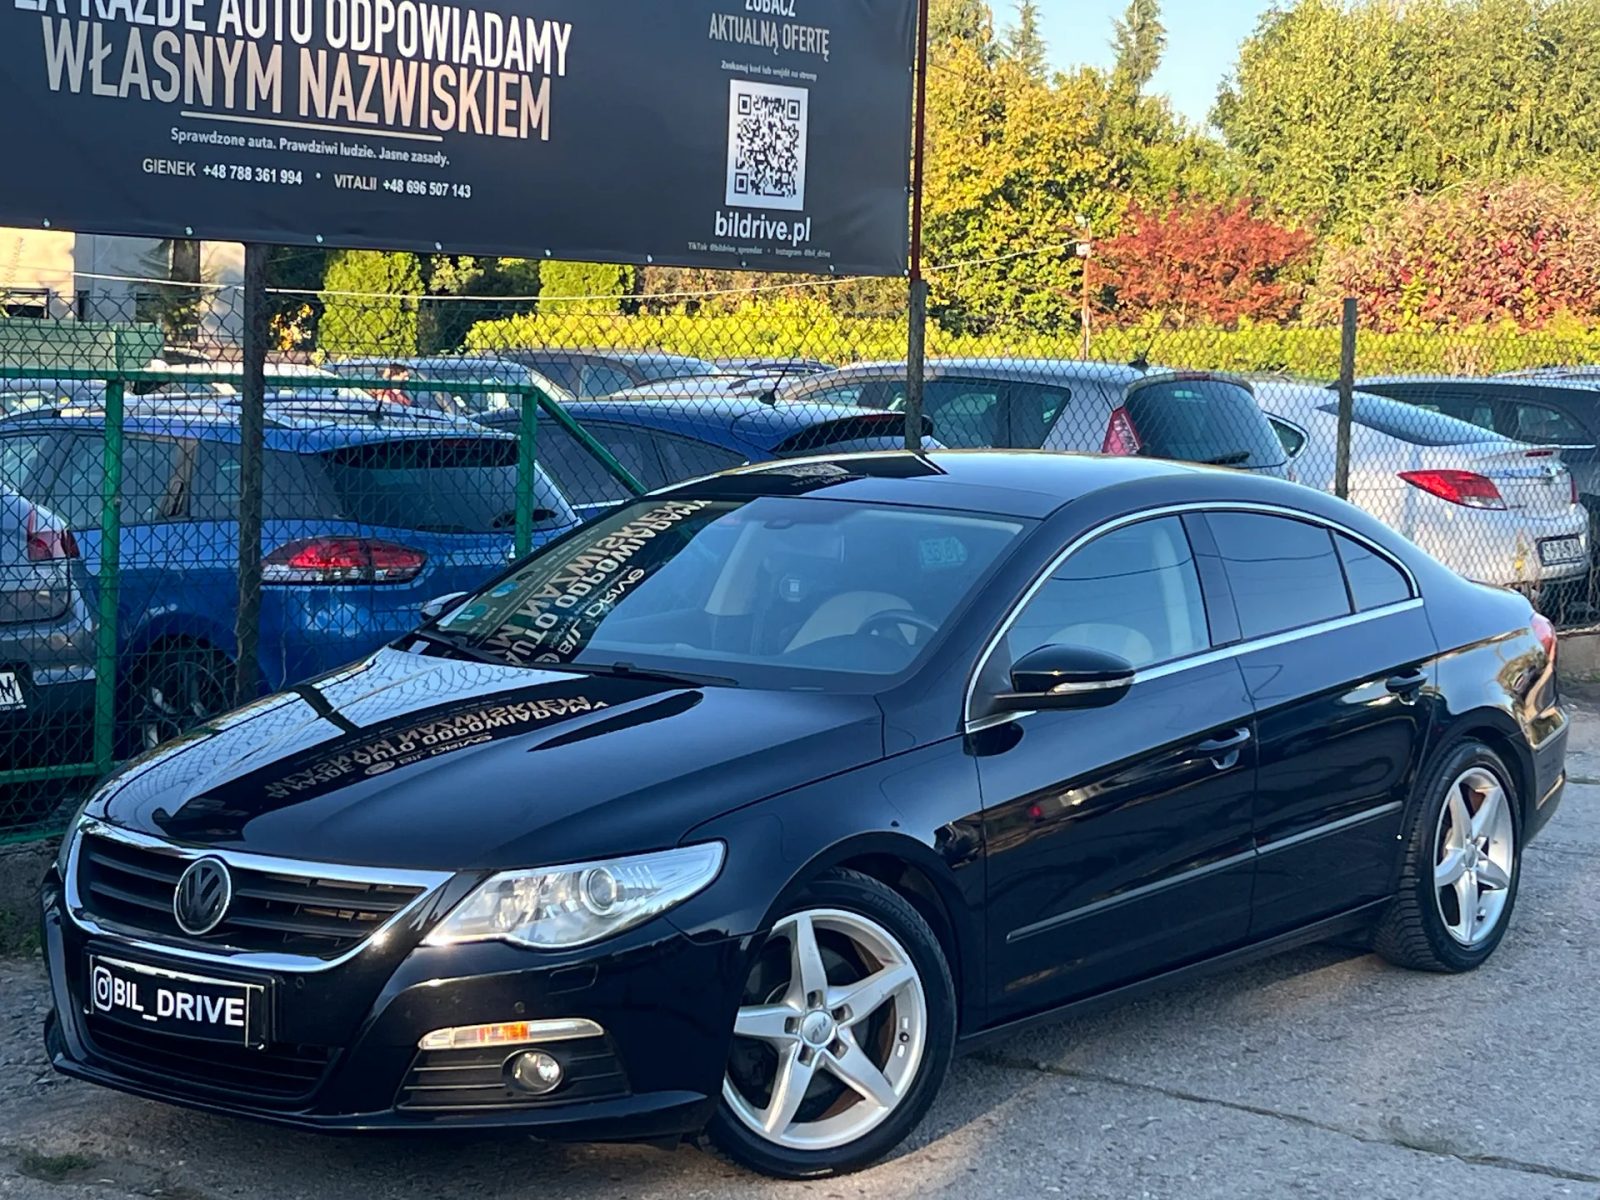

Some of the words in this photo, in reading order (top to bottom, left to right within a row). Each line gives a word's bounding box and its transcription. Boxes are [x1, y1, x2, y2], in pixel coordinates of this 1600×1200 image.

[217, 0, 313, 44] AUTO
[325, 0, 572, 77] ODPOWIADAMY
[709, 12, 779, 56] AKTUALNĄ
[782, 23, 830, 63] OFERTĘ
[42, 16, 282, 113] WŁASNYM
[299, 48, 550, 141] NAZWISKIEM
[171, 127, 245, 145] Sprawdzone
[247, 136, 277, 149] auta.
[279, 137, 338, 155] Prawdziwi
[340, 142, 377, 159] ludzie.
[378, 147, 410, 162] Jasne
[411, 151, 450, 168] zasady.
[142, 158, 196, 177] GIENEK
[202, 164, 227, 179] +48
[229, 165, 252, 181] 788
[255, 167, 277, 183] 361
[280, 169, 303, 185] 994
[383, 178, 404, 193] +48
[406, 180, 427, 195] 696
[429, 182, 449, 197] 507
[451, 183, 471, 199] 143
[715, 210, 811, 247] bildrive.pl
